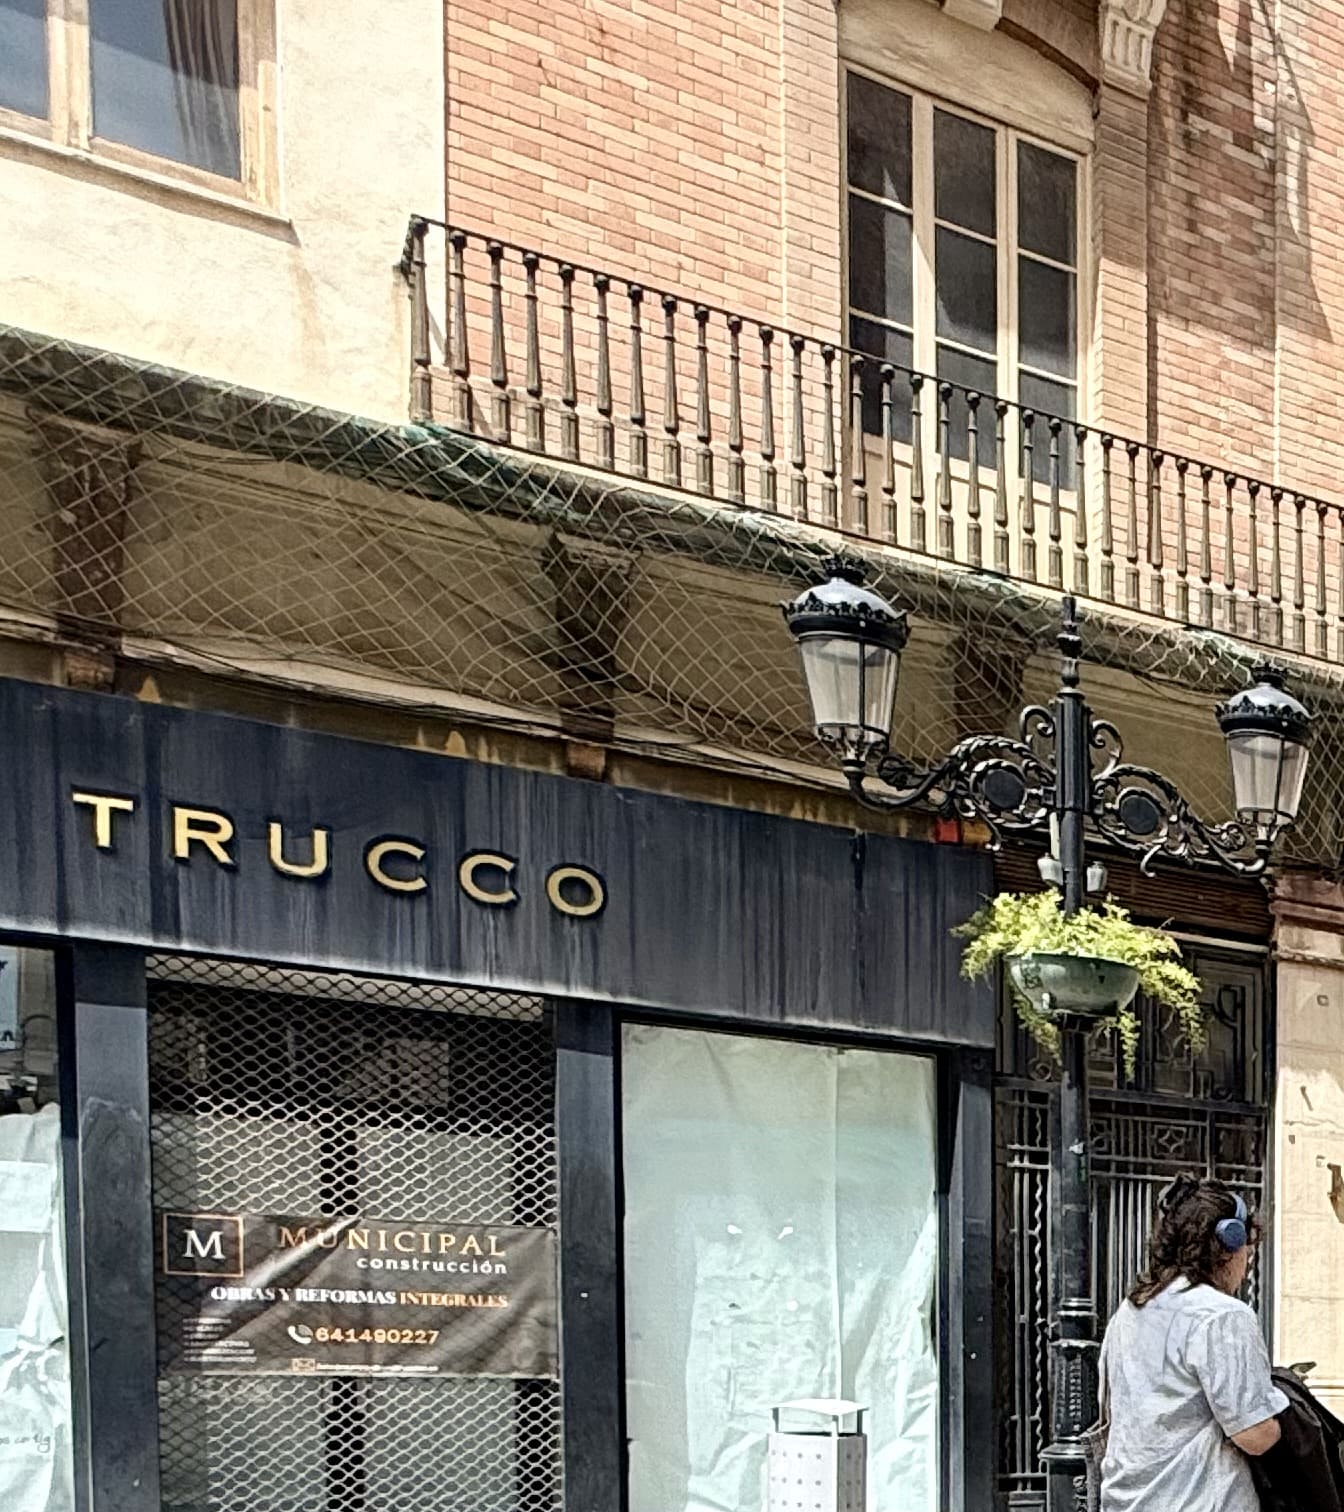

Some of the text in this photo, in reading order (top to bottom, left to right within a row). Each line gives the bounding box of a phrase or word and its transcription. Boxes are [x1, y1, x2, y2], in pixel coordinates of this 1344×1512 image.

[72, 791, 606, 918] TRUCCO
[182, 1228, 226, 1260] M
[279, 1226, 507, 1258] MUNICIPAL
[356, 1256, 508, 1275] construcción
[210, 1286, 509, 1309] OBRAS Y REFORMAS INTEGRALES
